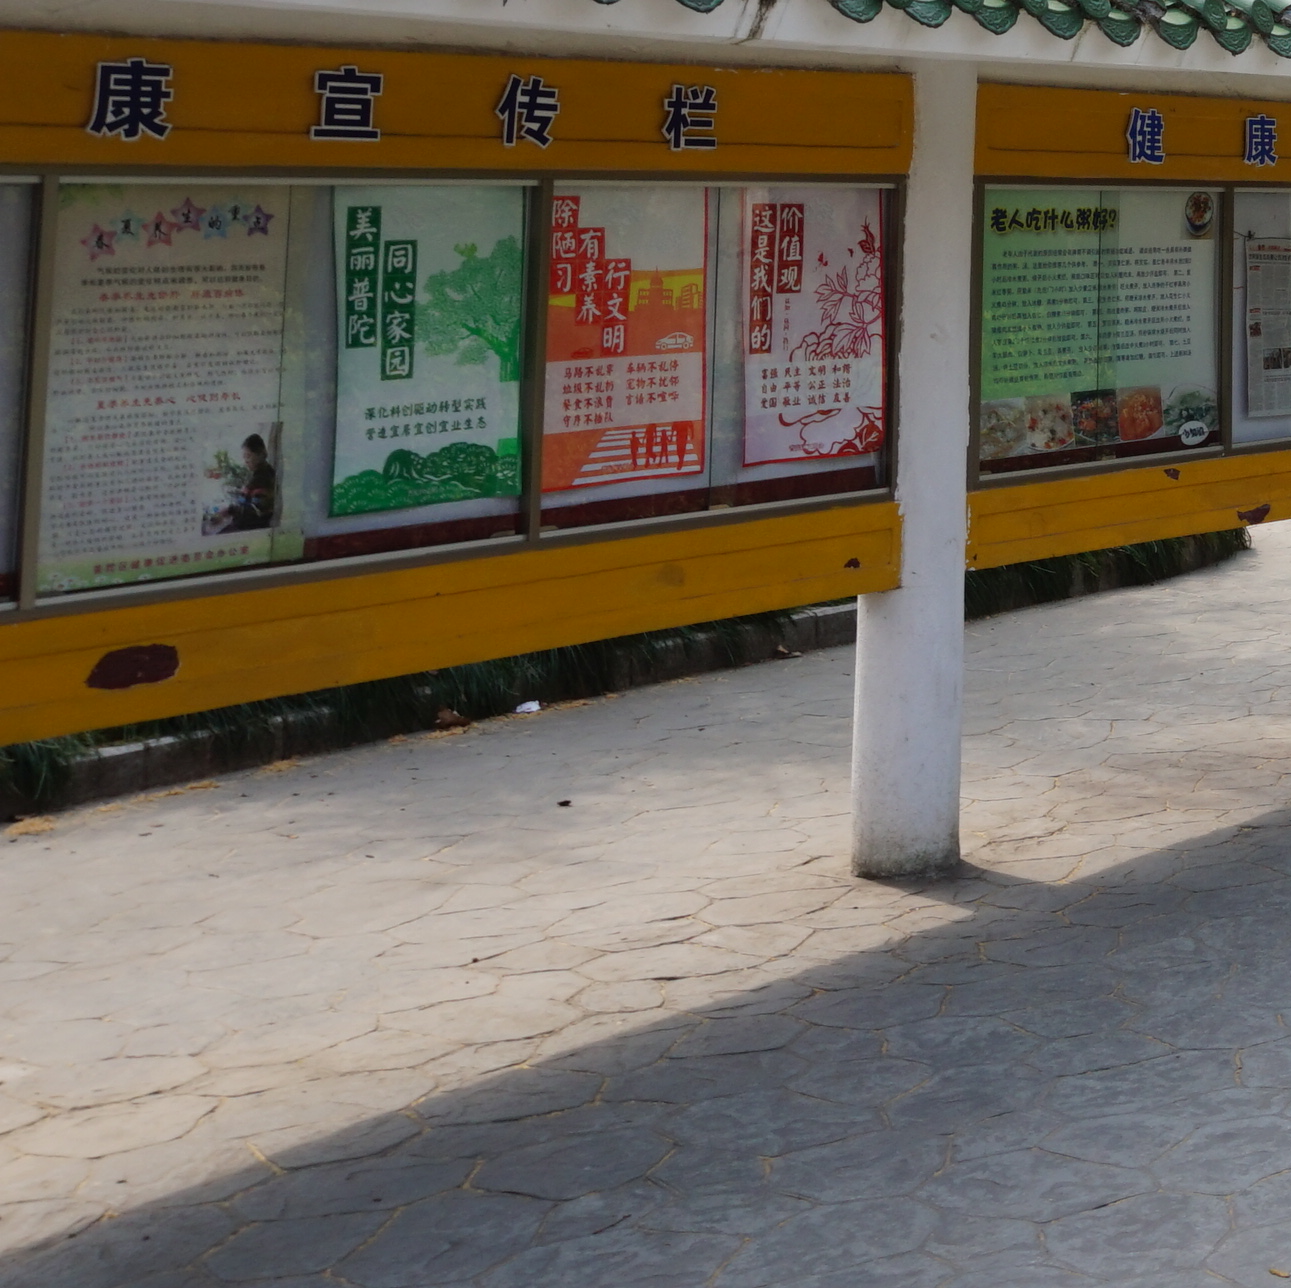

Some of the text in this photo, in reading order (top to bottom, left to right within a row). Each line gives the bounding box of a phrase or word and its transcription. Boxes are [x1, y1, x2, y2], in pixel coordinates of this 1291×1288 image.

[87, 58, 718, 151] 康宣传栏
[95, 204, 262, 250] 春夏养生的重点
[552, 200, 578, 292] 除陋习
[779, 206, 802, 291] 价值观
[348, 208, 377, 344] 美丽普陀
[577, 231, 603, 324] 有素养
[751, 207, 775, 351] 这是我们的
[385, 243, 415, 376] 同心家园
[603, 261, 630, 353] 行文明
[563, 376, 679, 394] 垃圾不乱扔 宠物不扰邻
[626, 359, 679, 374] 车辆不乱停
[761, 363, 852, 380] 富强 民主 文明 和谐
[761, 377, 851, 394] 自由 平等 公正 法治
[364, 397, 487, 420] 深化科创驱动转型实践
[626, 391, 679, 405] 言语不喧哗
[760, 392, 851, 410] 爱国 敬业 诚信 友善
[365, 416, 488, 440] 营造宜居宜创宜业生态
